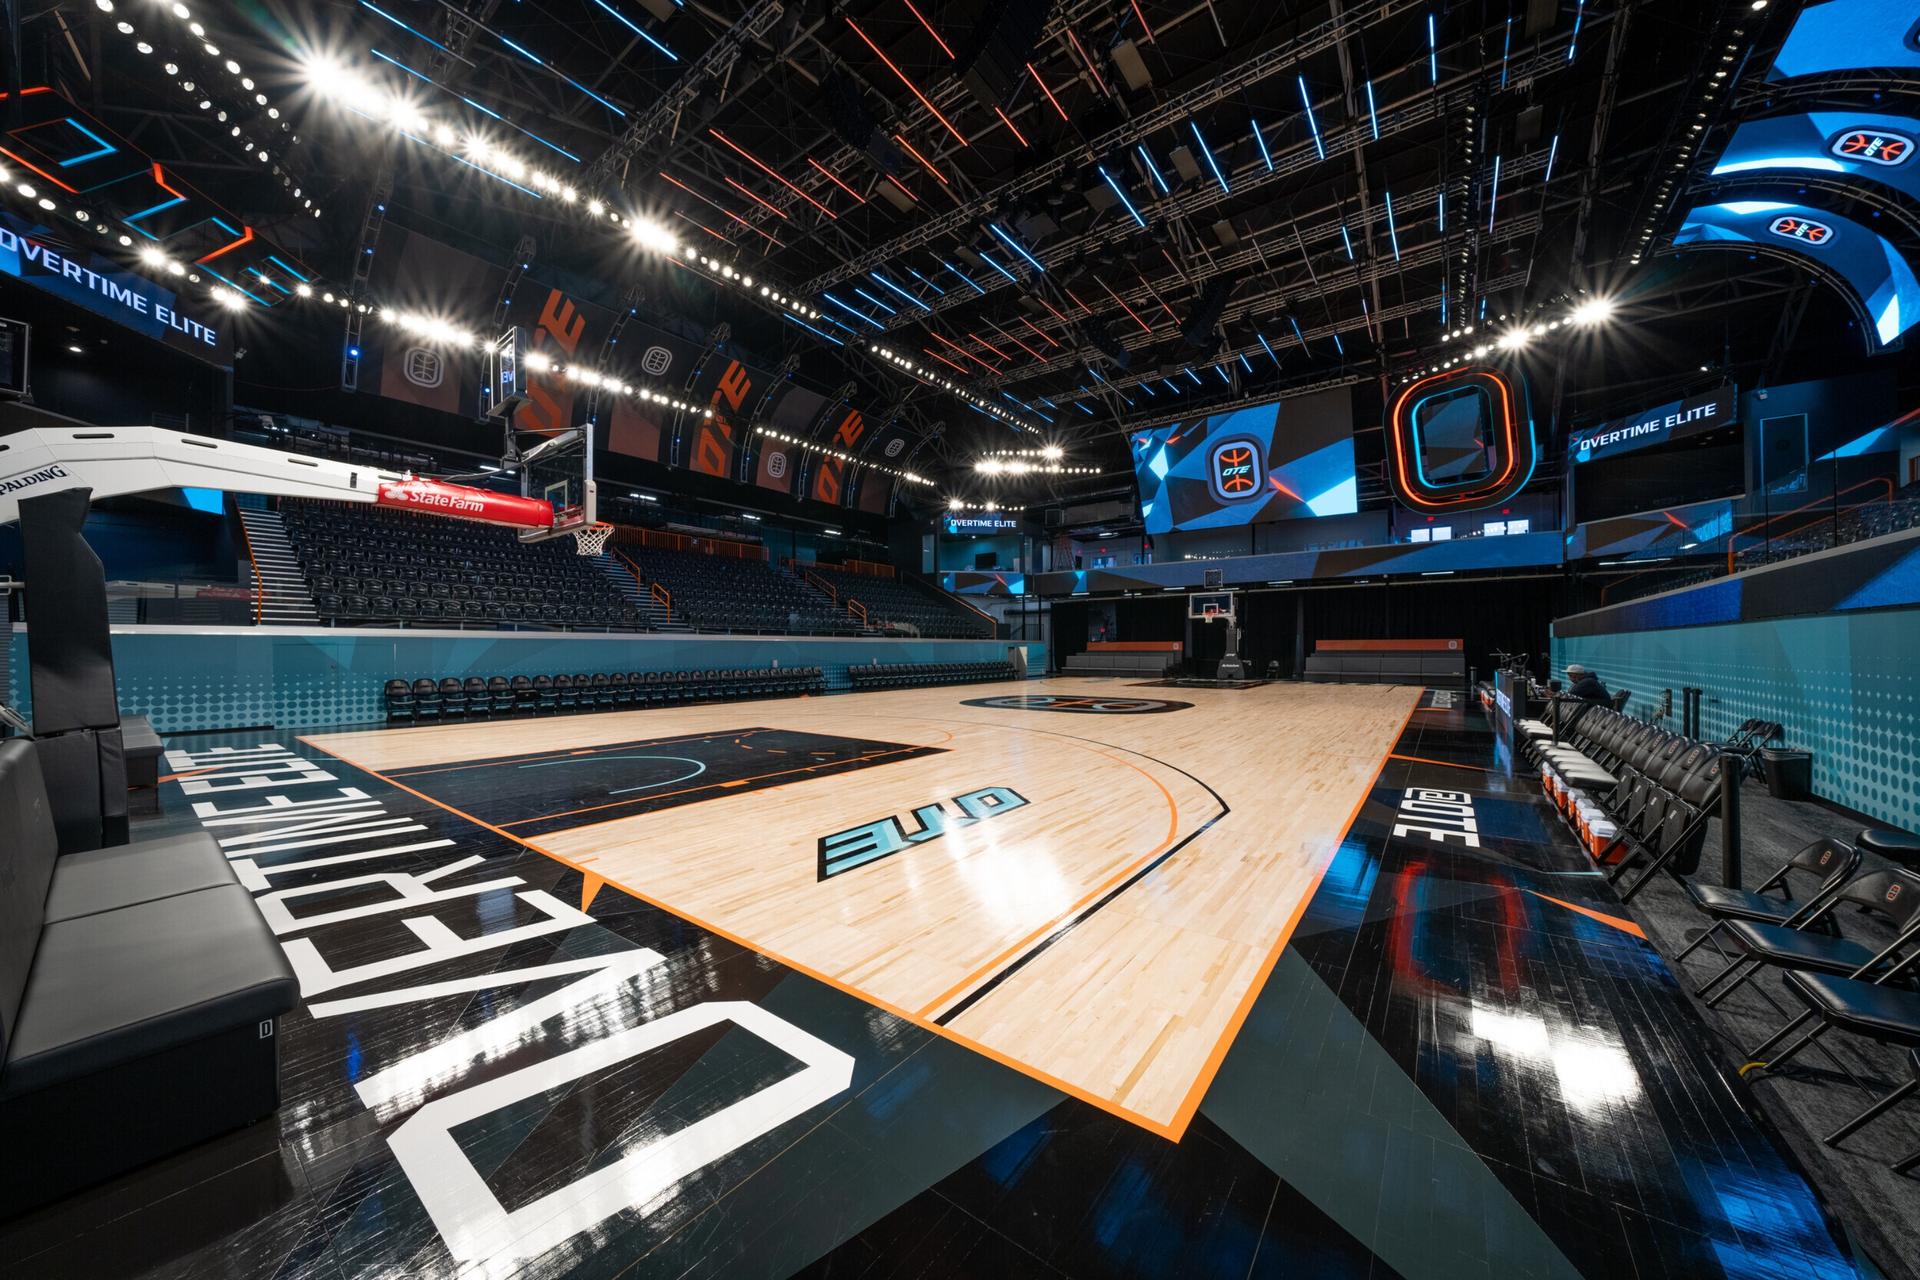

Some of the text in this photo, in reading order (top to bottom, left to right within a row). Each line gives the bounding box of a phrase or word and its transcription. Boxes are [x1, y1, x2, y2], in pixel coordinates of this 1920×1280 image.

[0, 227, 216, 346] OVERTIME ELITE
[1580, 402, 1717, 451] OVERTIME ELITE
[1222, 464, 1251, 477] OTE
[950, 519, 1017, 528] OVERTIME ELITE
[816, 785, 1033, 884] OTE
[1393, 787, 1480, 848] @OTE
[190, 786, 857, 1266] OVERTIME
